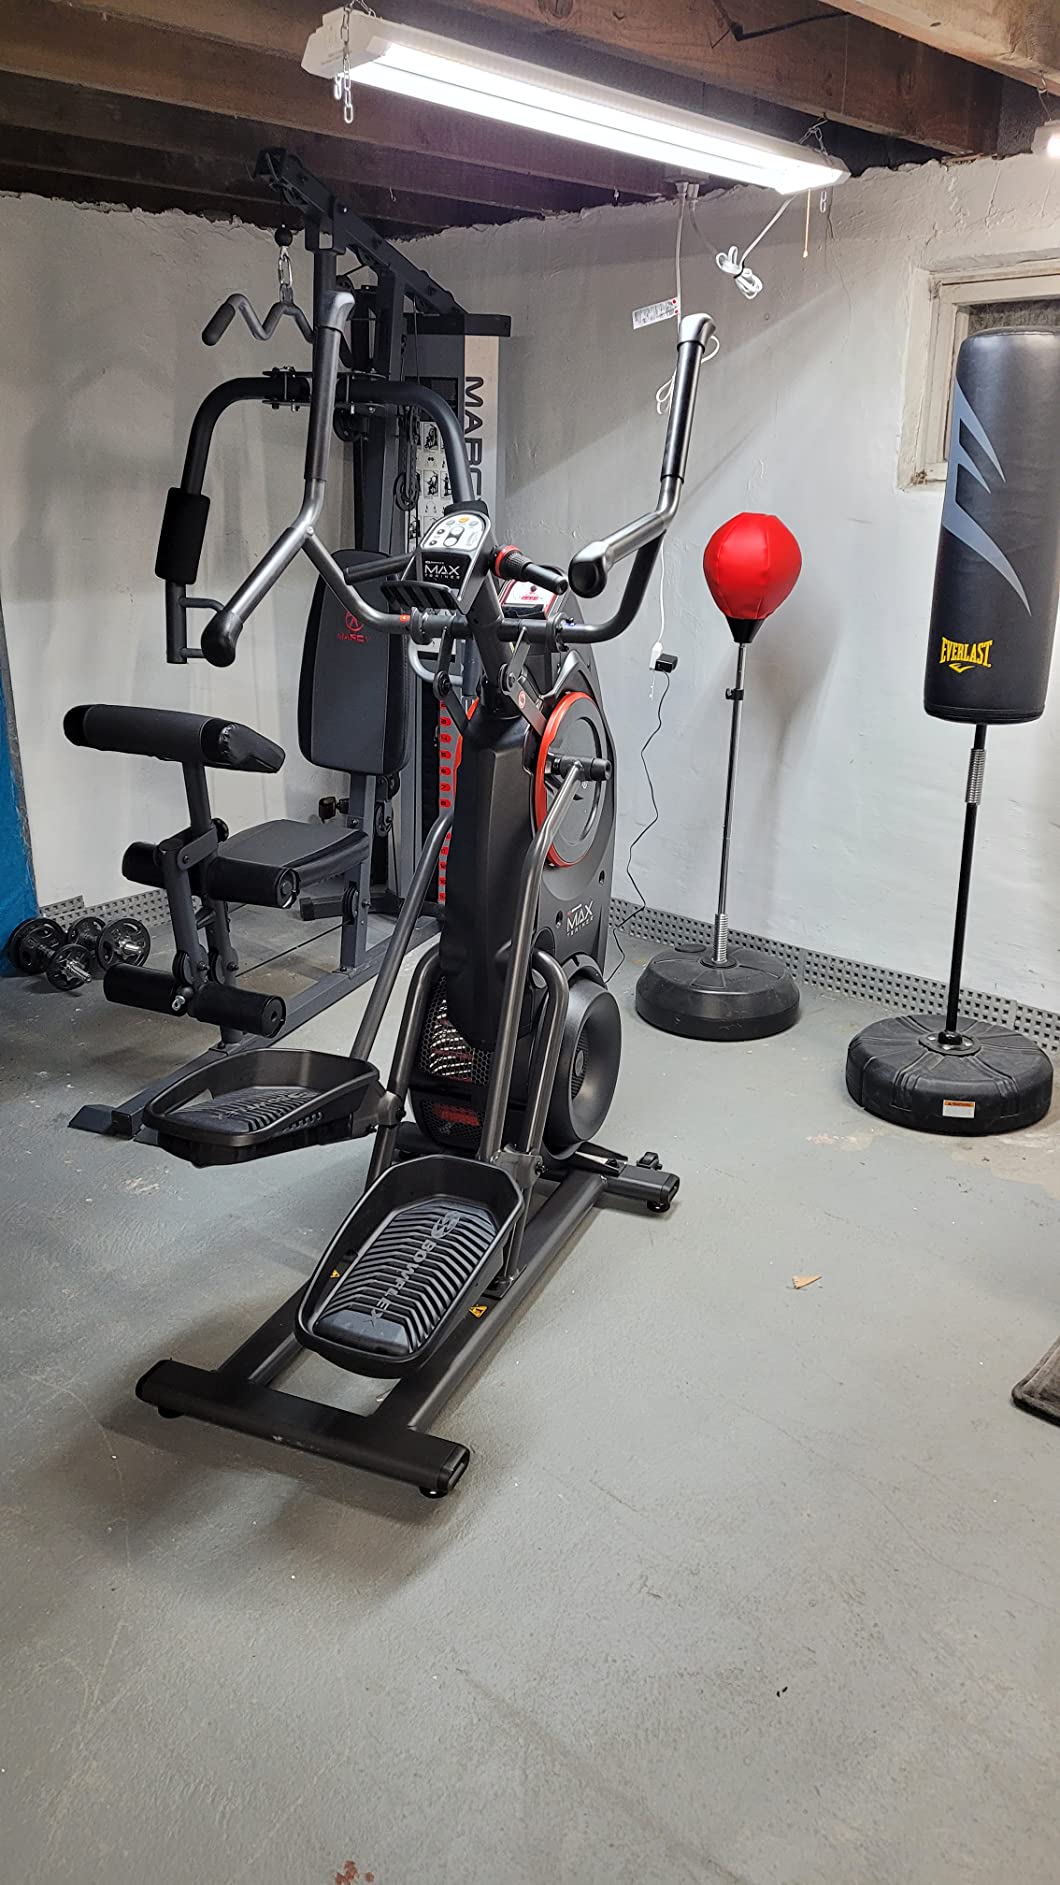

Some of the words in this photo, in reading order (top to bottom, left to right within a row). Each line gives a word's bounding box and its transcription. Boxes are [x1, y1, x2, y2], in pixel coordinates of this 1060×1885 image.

[464, 376, 484, 502] MARC
[424, 564, 460, 576] MAX
[939, 636, 993, 668] EVERLAST
[566, 900, 594, 932] MAX
[364, 1239, 437, 1327] BOWFLEX
